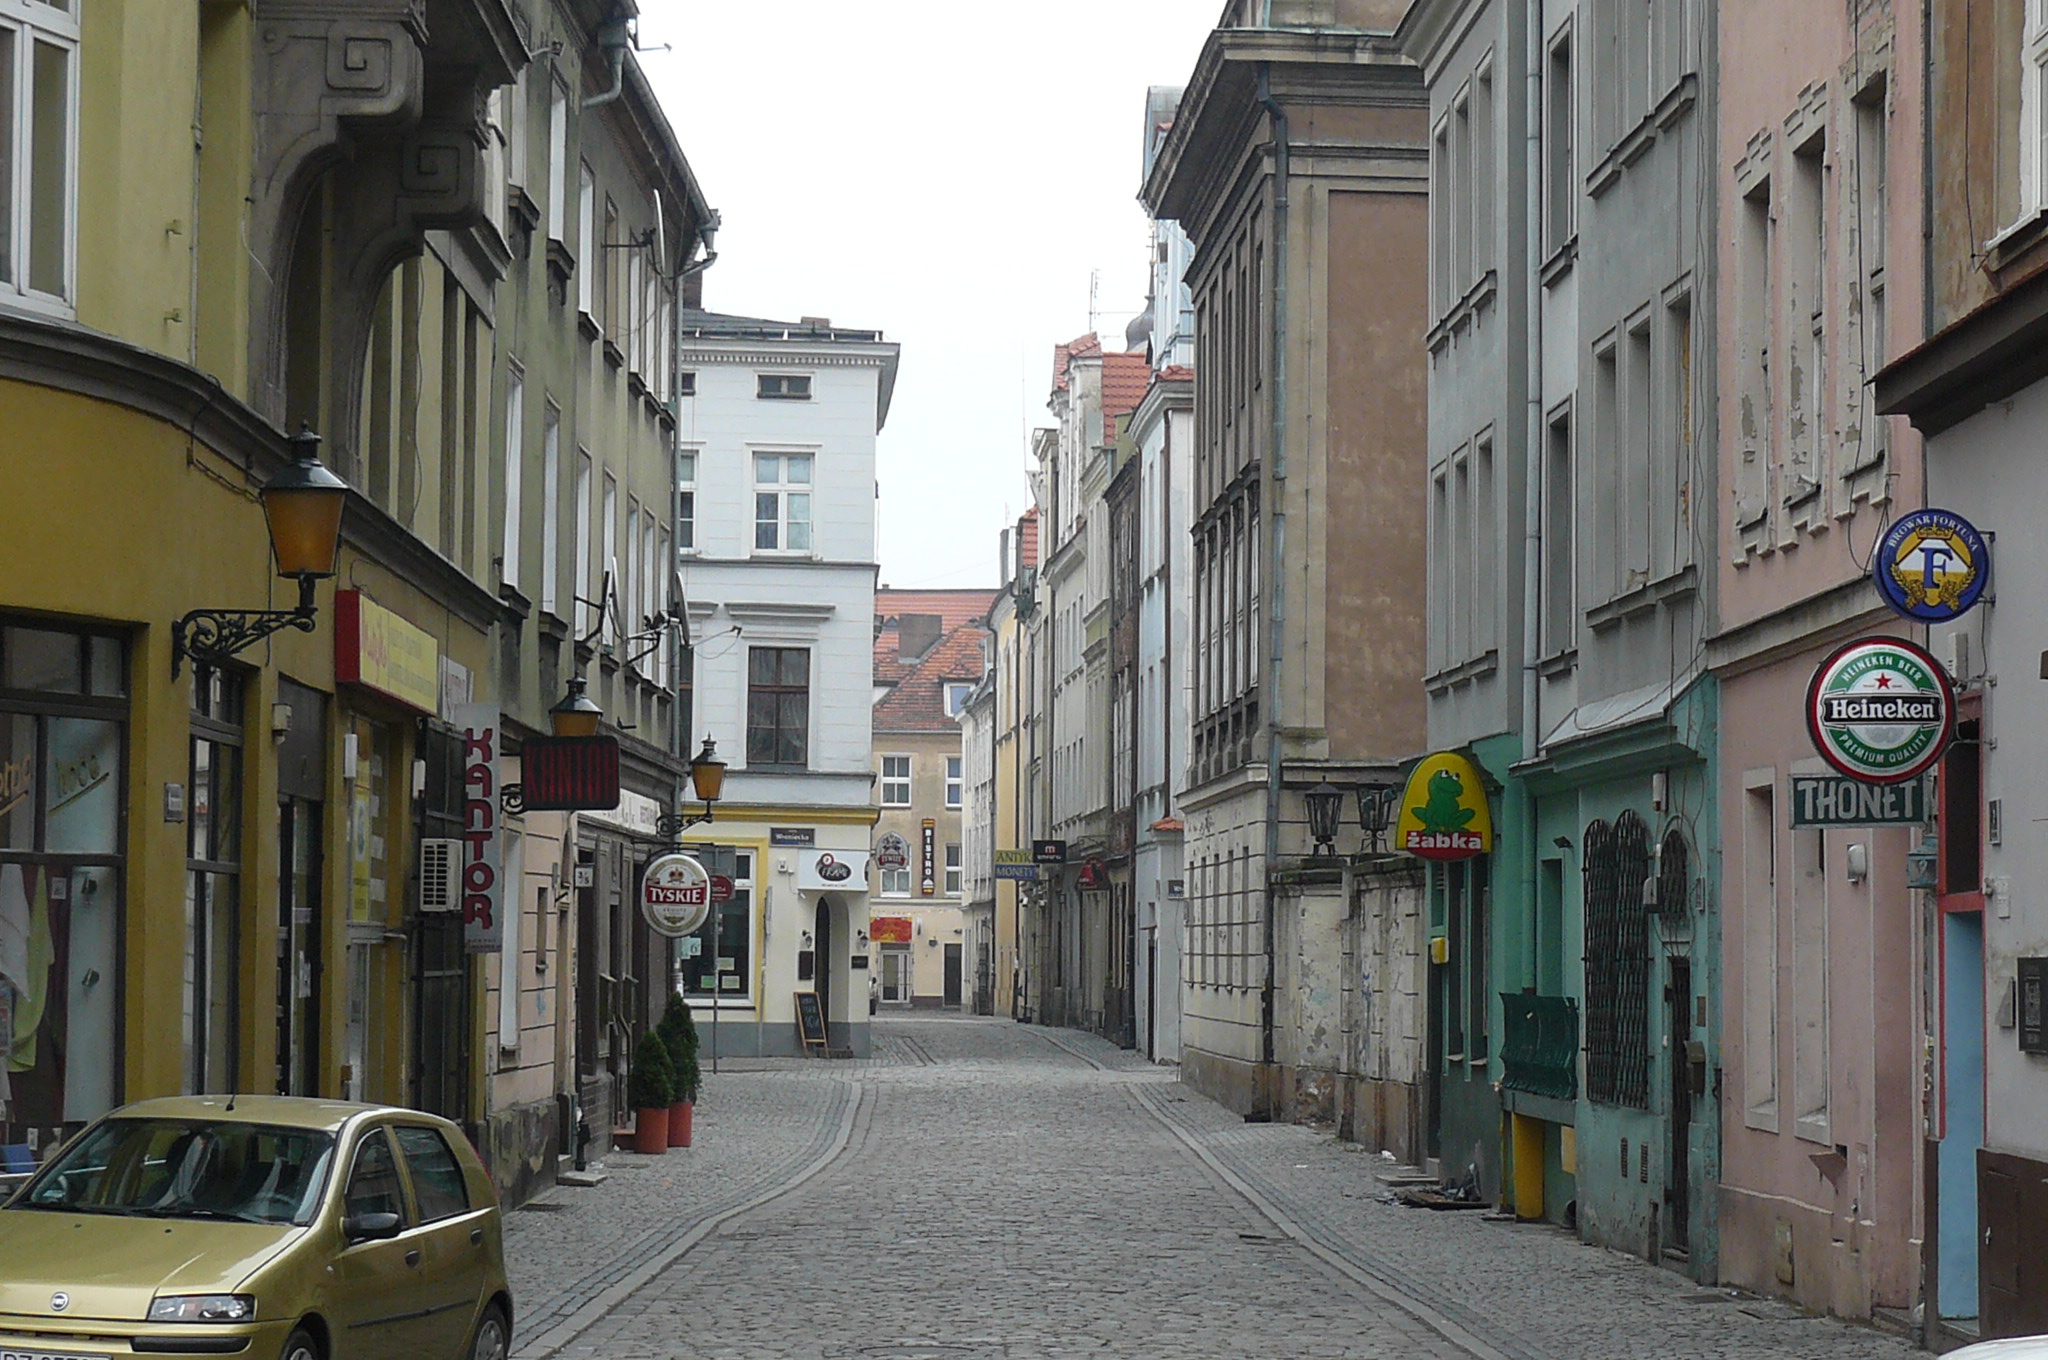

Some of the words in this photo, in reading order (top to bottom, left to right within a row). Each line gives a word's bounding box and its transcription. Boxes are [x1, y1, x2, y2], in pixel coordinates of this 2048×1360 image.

[1888, 515, 1931, 548] BROWAR
[1933, 515, 1979, 551] FORTUNA
[1919, 547, 1954, 589] F
[1840, 655, 1893, 682] HEINEKEN
[1897, 659, 1924, 681] BEER
[1830, 698, 1935, 719] Heineken
[1838, 733, 1884, 764] PREMIUM
[1888, 734, 1927, 763] QUALITY
[524, 744, 618, 800] KANTOR
[1797, 780, 1917, 820] THONET
[464, 727, 494, 930] KANTOR
[1407, 831, 1482, 850] żabka
[997, 852, 1033, 863] ANTYK
[650, 887, 702, 904] TYSKIE
